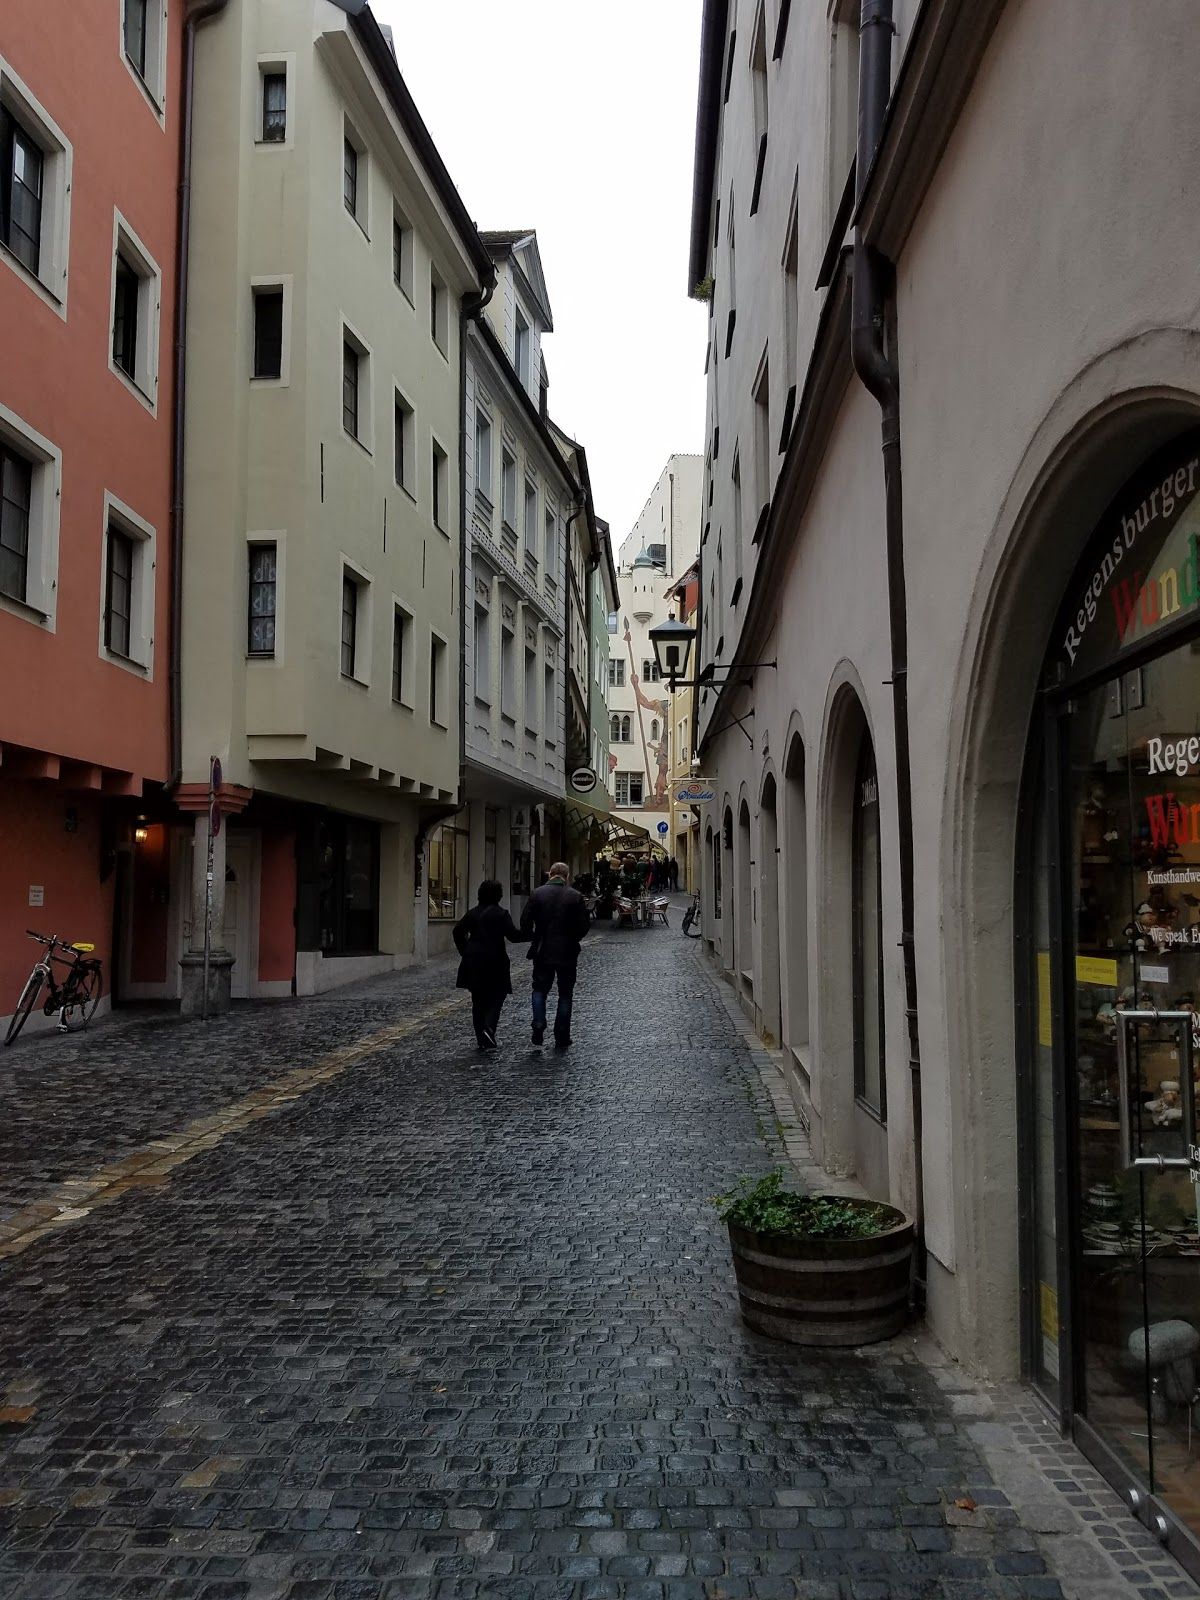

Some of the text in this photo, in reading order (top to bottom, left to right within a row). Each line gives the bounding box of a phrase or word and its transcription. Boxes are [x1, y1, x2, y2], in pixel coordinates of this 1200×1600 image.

[1063, 457, 1200, 667] Regensburger
[1147, 736, 1200, 777] Rege
[1150, 928, 1162, 942] We
[1165, 928, 1188, 946] speak
